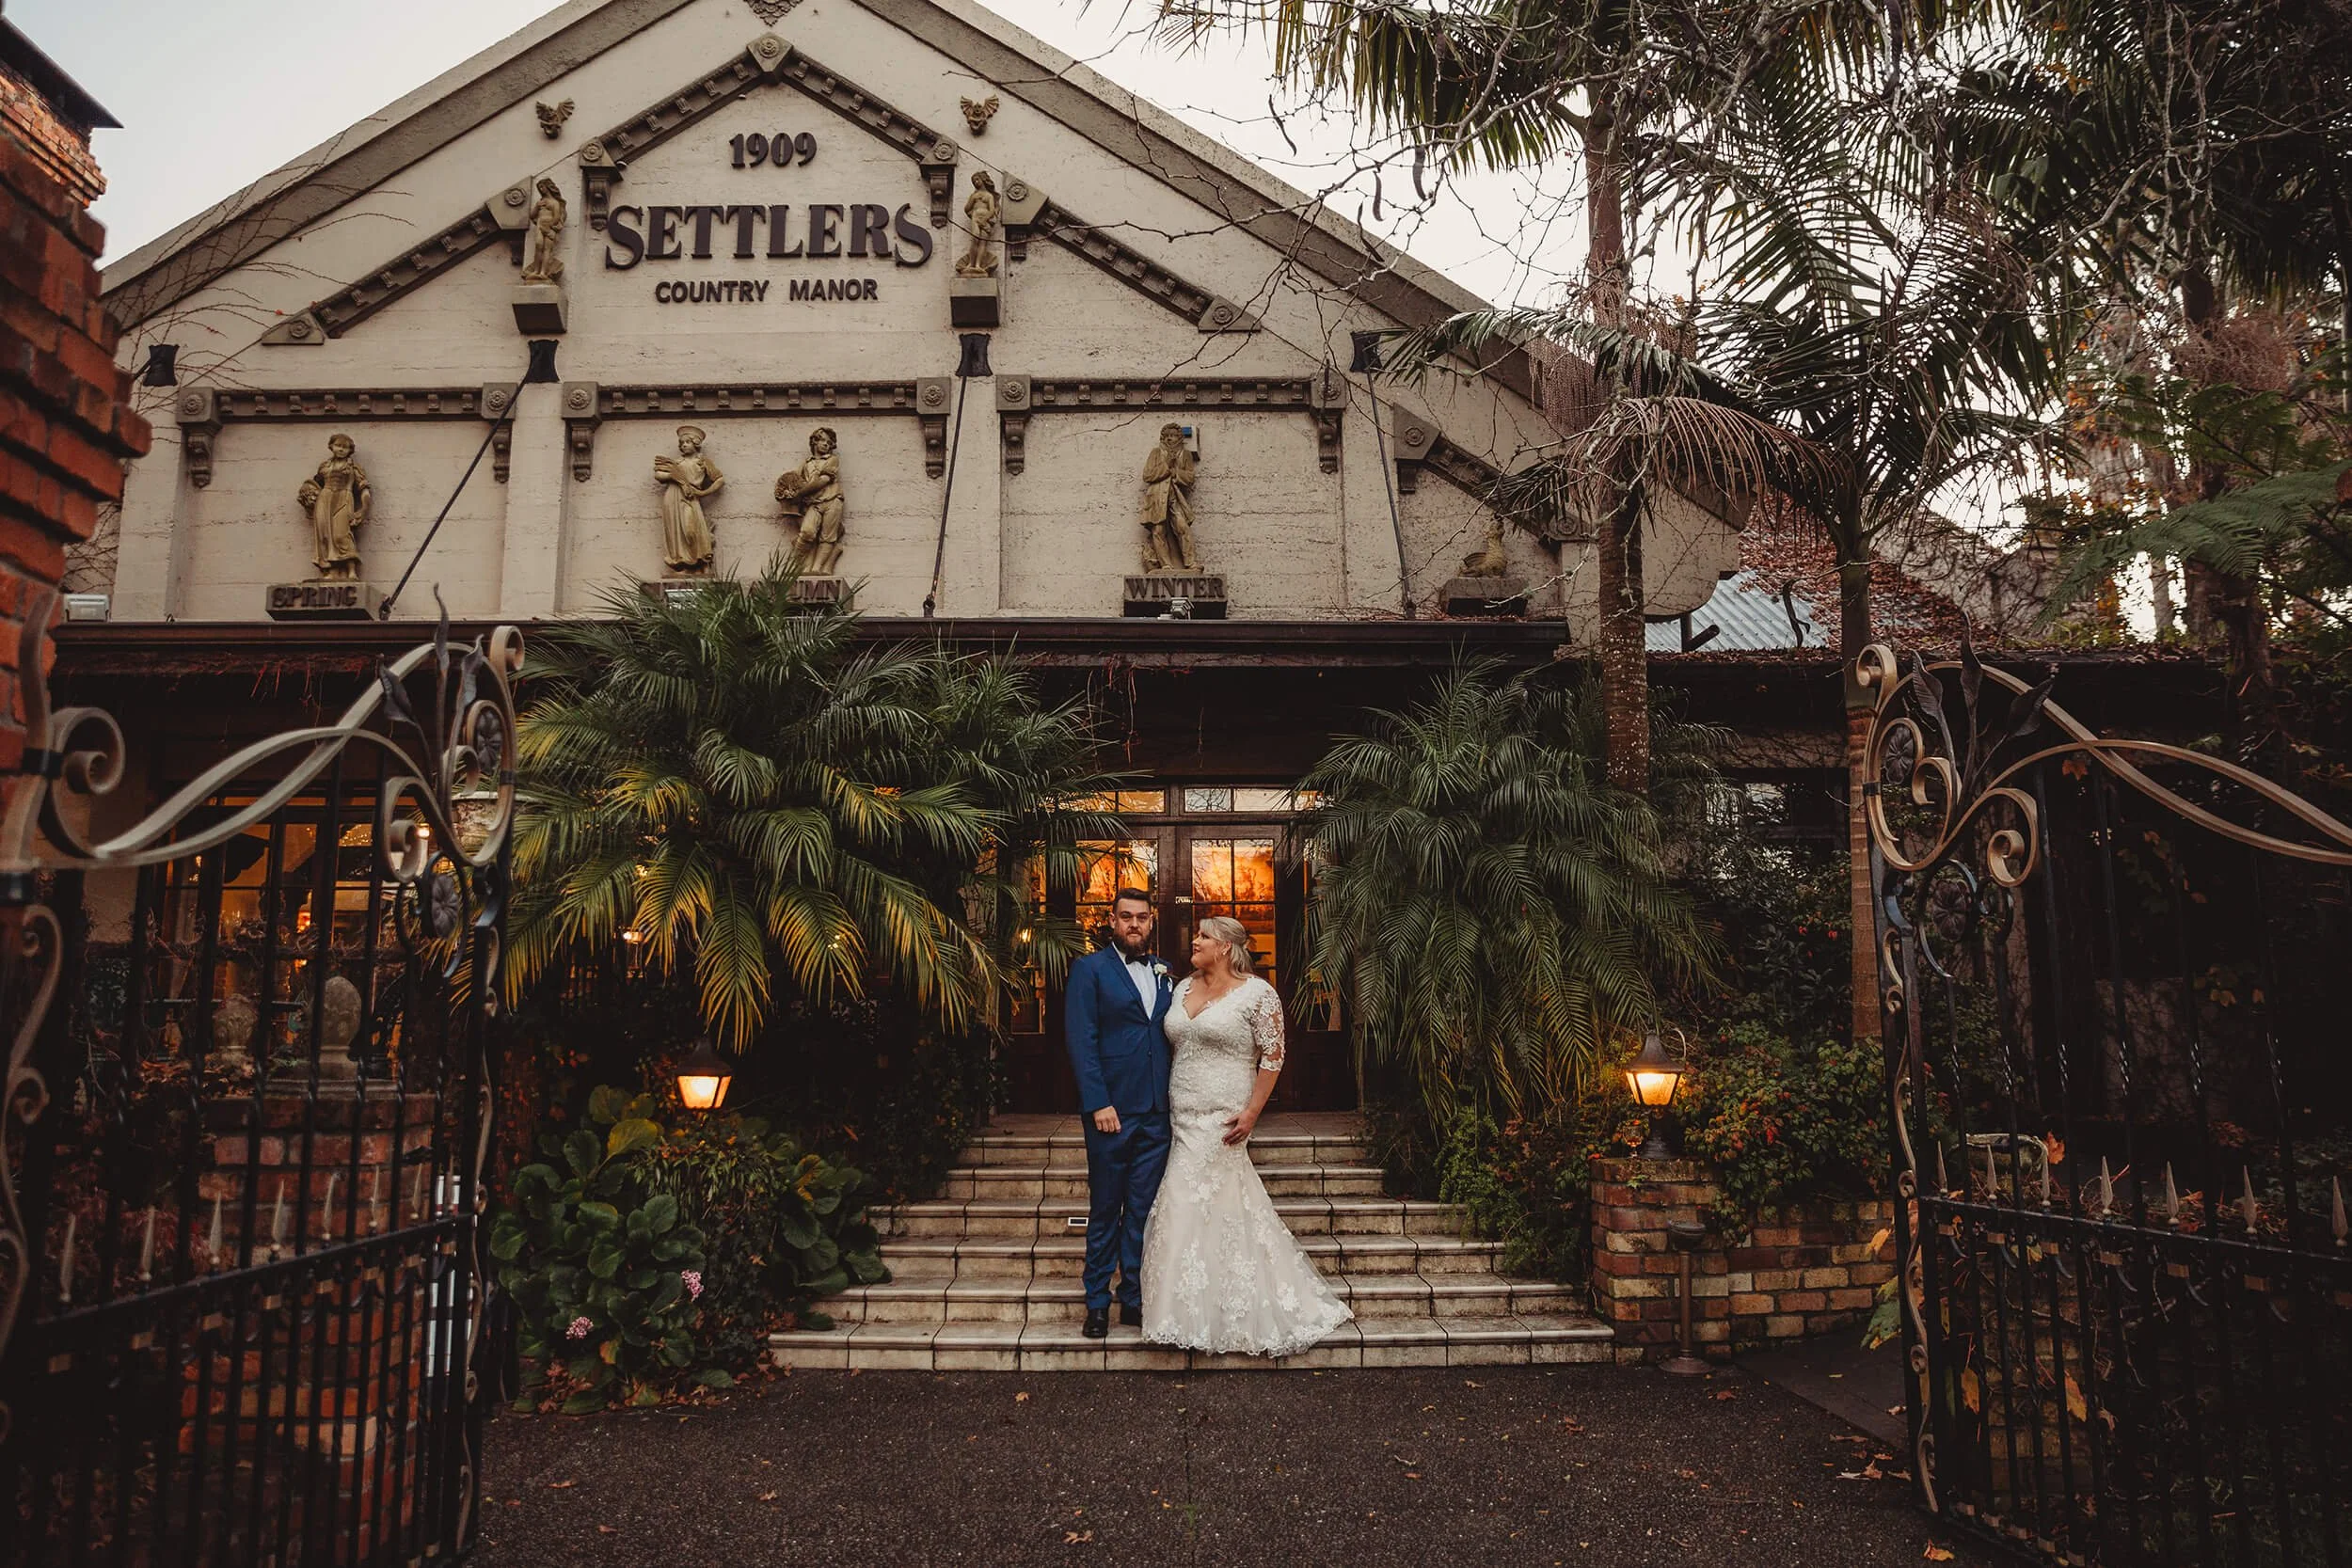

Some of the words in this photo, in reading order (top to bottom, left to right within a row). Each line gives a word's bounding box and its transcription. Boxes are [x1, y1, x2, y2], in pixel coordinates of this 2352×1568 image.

[729, 133, 817, 167] 1909
[606, 203, 932, 269] SETTLERS
[655, 279, 770, 304] COUNTRY
[789, 278, 878, 302] MANOR
[274, 586, 357, 608] SPRING
[1126, 578, 1225, 598] WINTER
